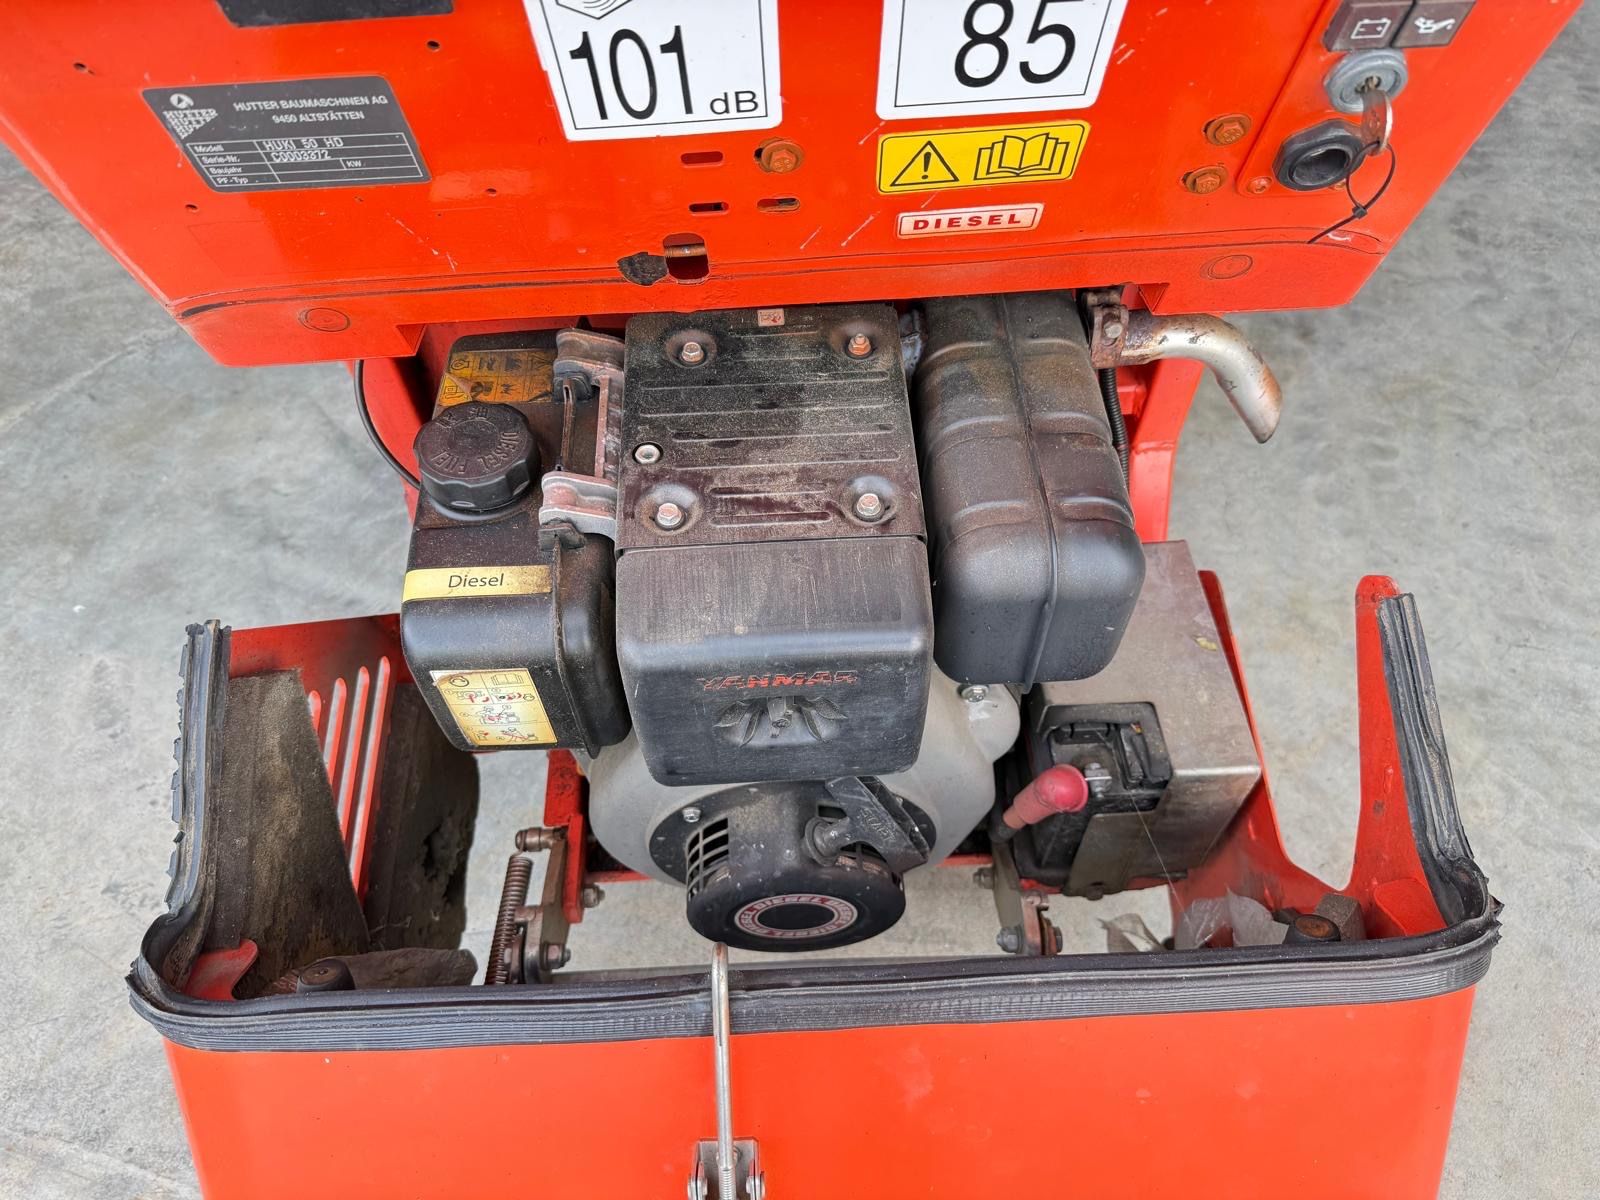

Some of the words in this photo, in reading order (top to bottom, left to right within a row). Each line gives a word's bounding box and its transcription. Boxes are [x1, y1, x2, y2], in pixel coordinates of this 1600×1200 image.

[954, 0, 1076, 88] 85
[568, 25, 693, 120] 101
[710, 90, 759, 115] dB
[233, 101, 279, 111] HUTTER
[280, 97, 370, 109] BAUMASCHINEN
[371, 95, 389, 105] AG
[272, 114, 298, 123] 9450
[299, 111, 365, 122] ALTSTÄTTEN
[194, 144, 224, 153] Modell
[262, 139, 296, 151] HUKI
[301, 138, 318, 149] 50
[324, 137, 344, 147] HD
[201, 155, 240, 164] Serie-Nr.
[209, 166, 242, 175] Baujahr
[913, 214, 1021, 231] DIESEL
[448, 573, 504, 588] Diesel
[696, 670, 858, 691] YANMAR
